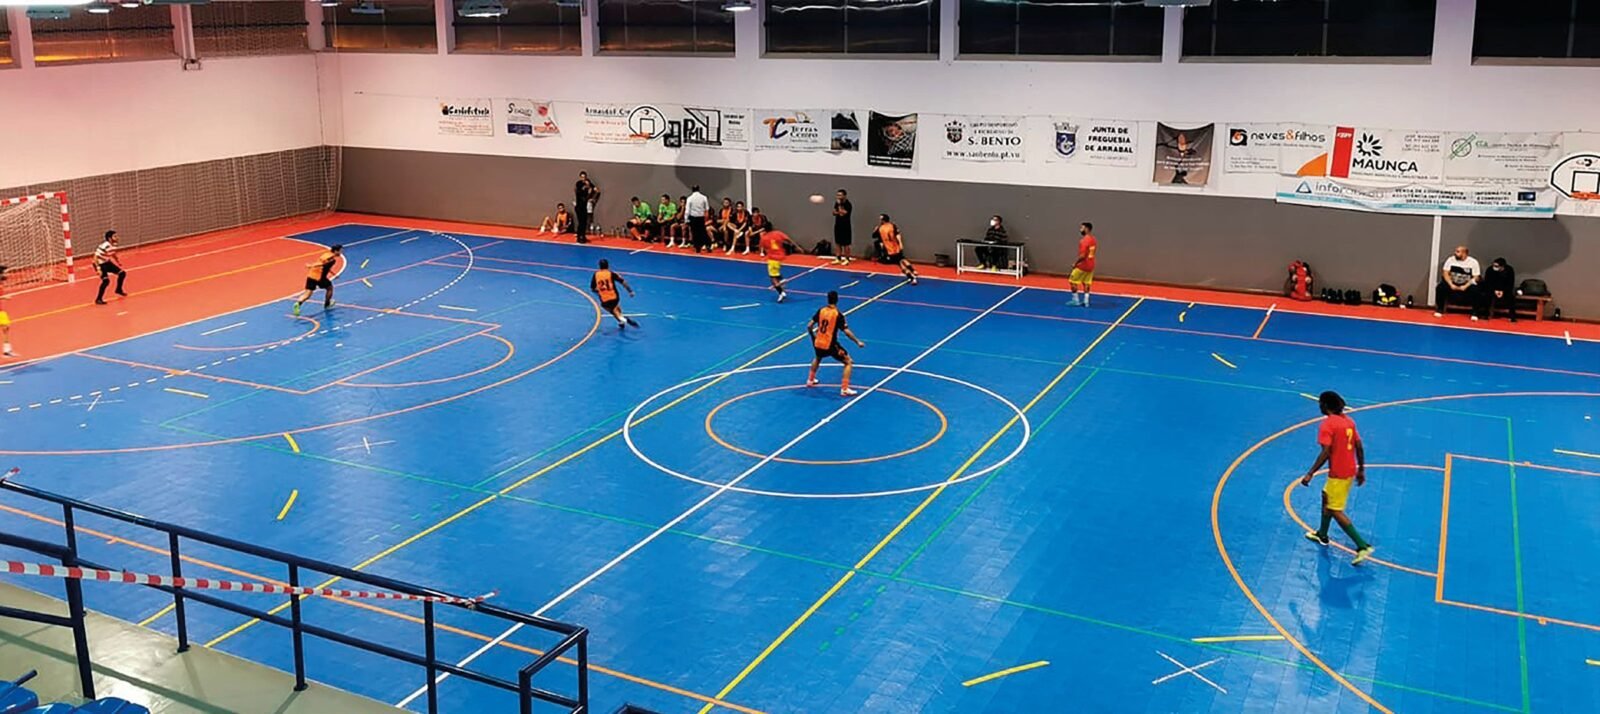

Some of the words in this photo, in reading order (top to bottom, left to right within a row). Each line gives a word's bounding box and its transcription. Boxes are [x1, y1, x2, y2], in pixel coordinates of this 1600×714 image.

[968, 136, 978, 145] S.
[981, 136, 1021, 146] BENTO
[1088, 135, 1131, 144] FREGUESIA
[1250, 129, 1326, 143] neves&filhos
[1097, 146, 1133, 154] ARRABAL
[1352, 158, 1418, 175] MAUNÇA
[597, 278, 611, 291] 21
[820, 319, 828, 333] 8
